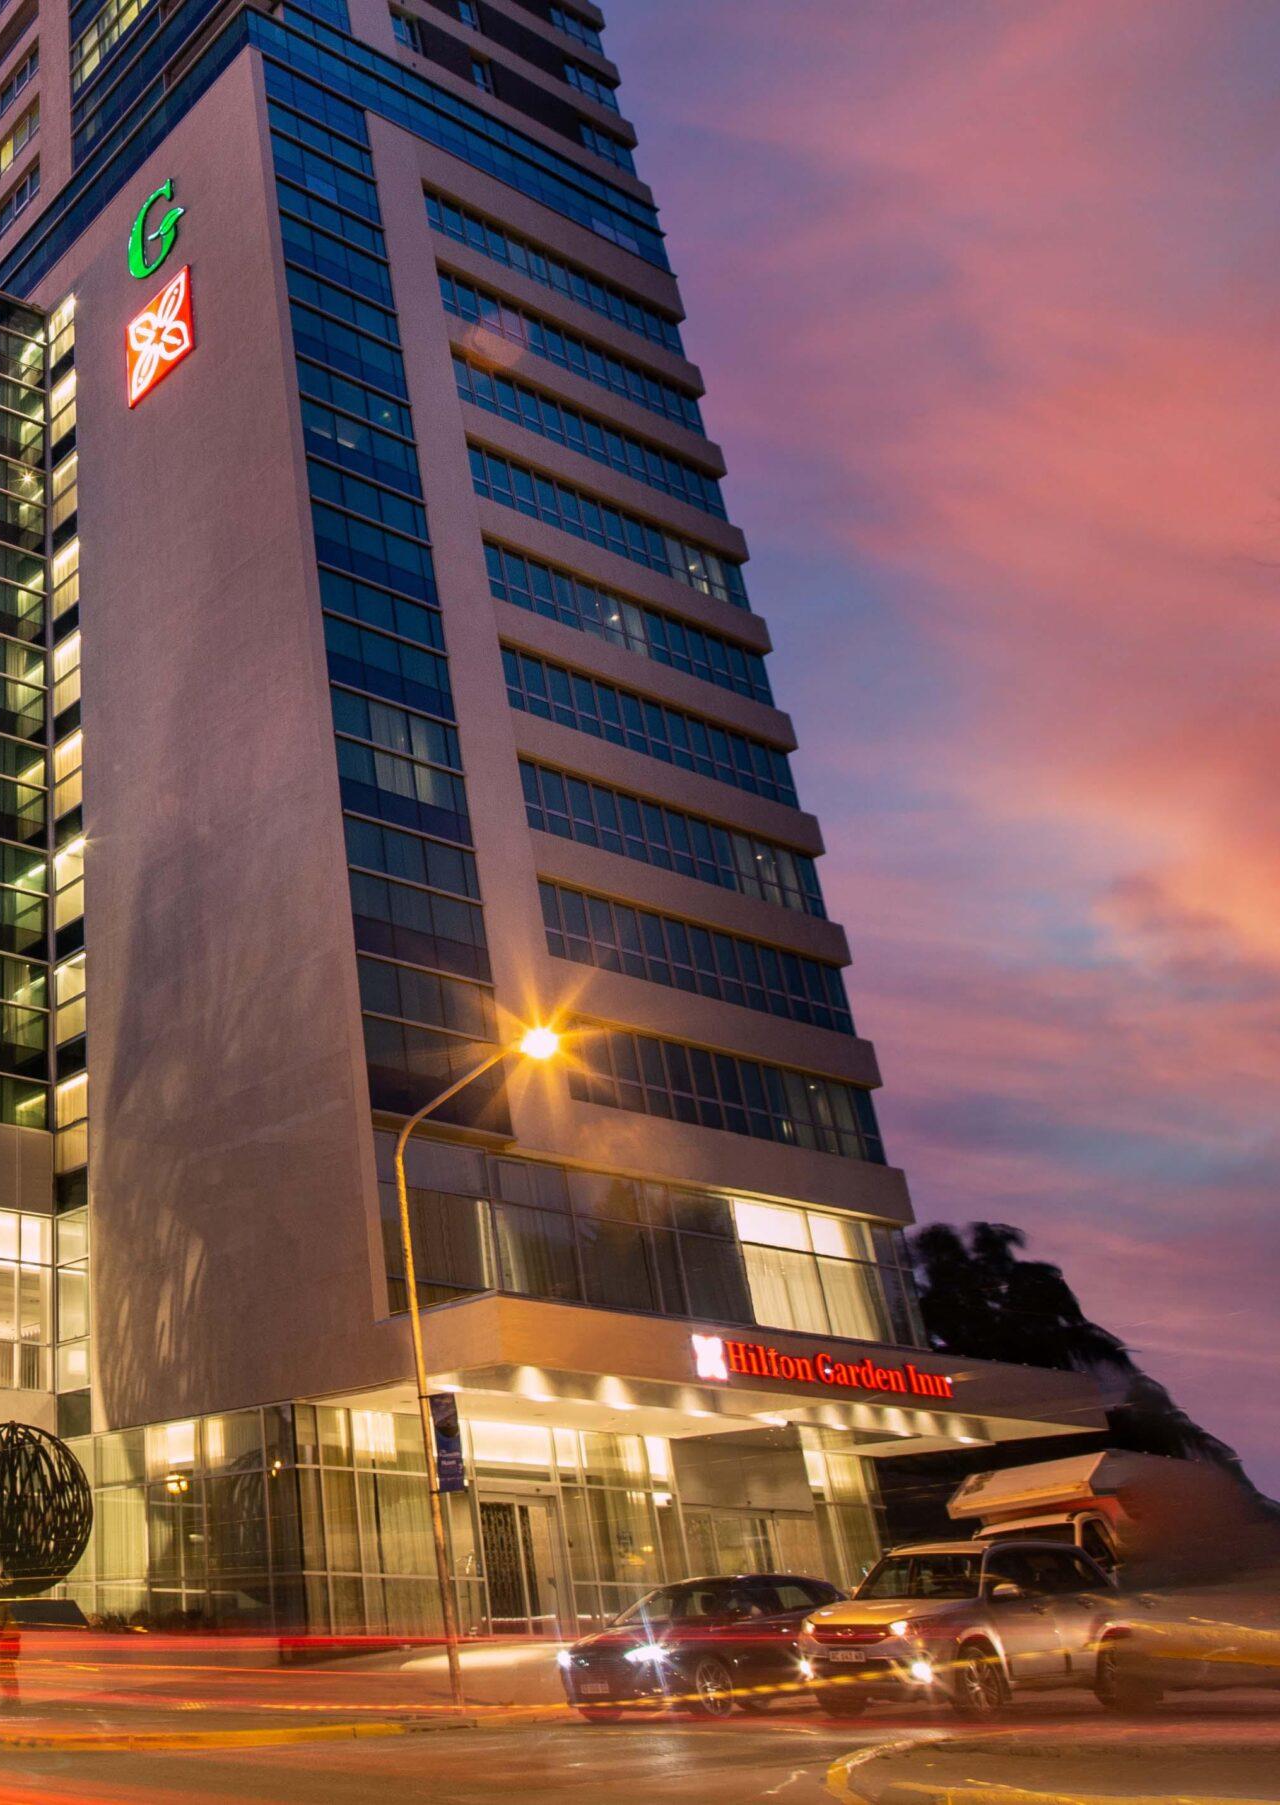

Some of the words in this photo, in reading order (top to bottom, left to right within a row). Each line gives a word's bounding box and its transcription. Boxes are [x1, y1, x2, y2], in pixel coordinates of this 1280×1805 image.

[724, 1340, 817, 1383] Hilton
[815, 1352, 908, 1393] Garden
[904, 1363, 954, 1399] Inn
